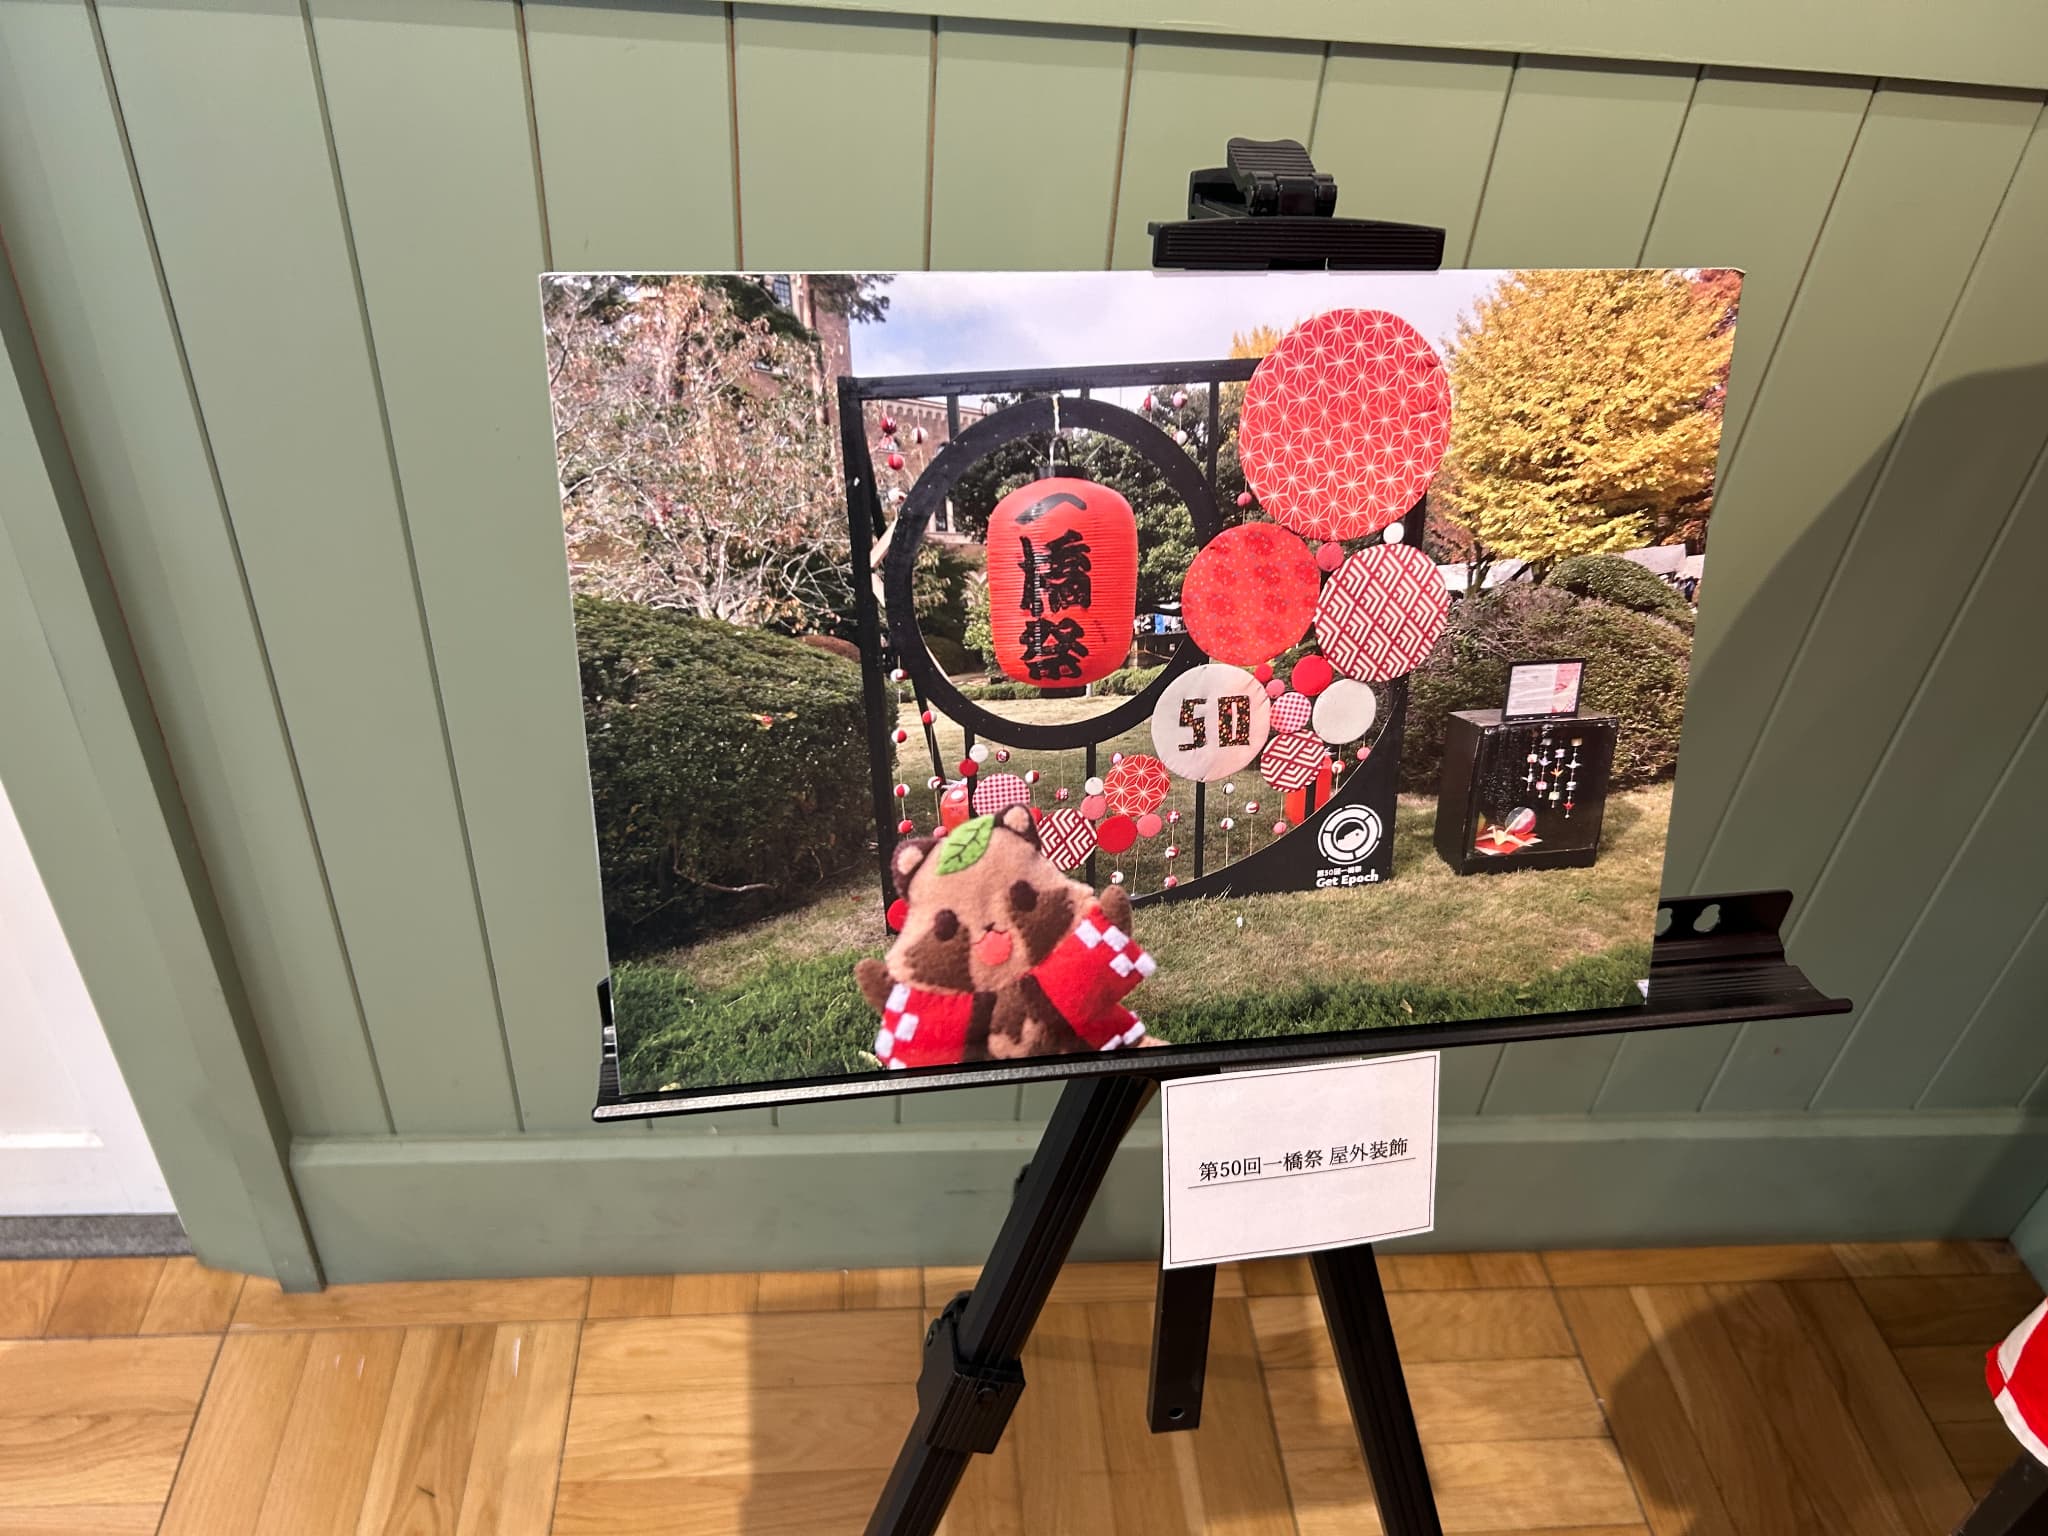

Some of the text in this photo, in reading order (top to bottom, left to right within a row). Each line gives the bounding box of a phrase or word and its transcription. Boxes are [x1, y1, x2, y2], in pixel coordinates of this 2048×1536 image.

[1178, 695, 1251, 752] 50
[1316, 868, 1379, 887] Get Epoch
[1199, 1137, 1409, 1182] 第50回一橋祭 屋外装飾
